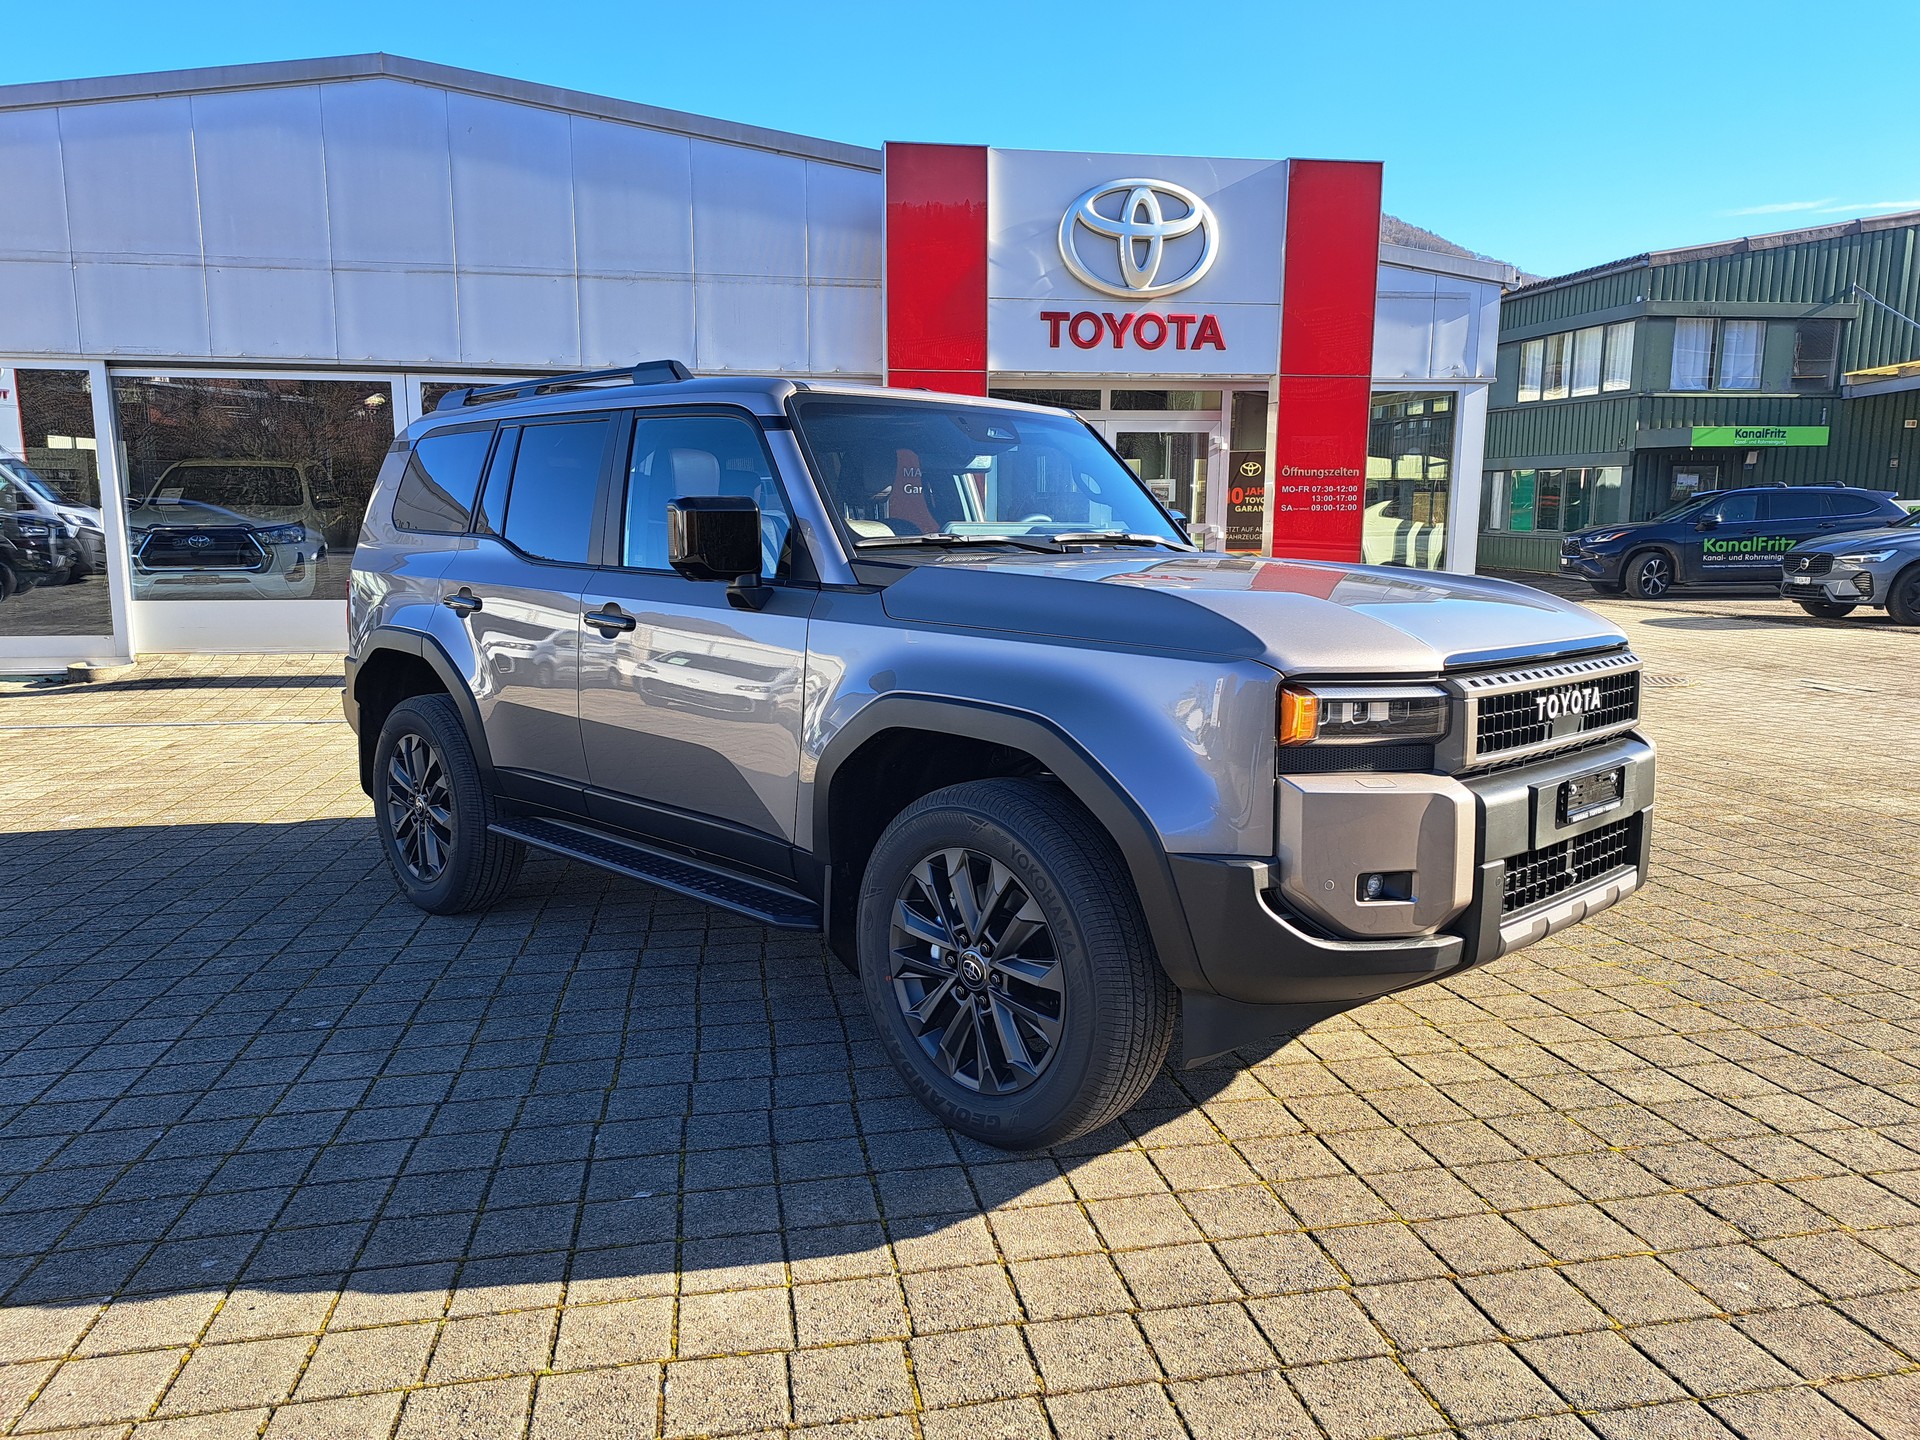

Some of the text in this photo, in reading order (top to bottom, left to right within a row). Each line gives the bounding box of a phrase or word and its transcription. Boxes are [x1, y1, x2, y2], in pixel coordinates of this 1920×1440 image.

[1040, 311, 1227, 350] TOYOTA
[1735, 428, 1787, 438] KanalFritz
[1281, 465, 1360, 479] Öffnungszeiten
[1281, 485, 1358, 493] MO-FR 07:30-12:00
[1311, 494, 1358, 502] 13:00-17:00
[1280, 504, 1293, 512] SA
[1311, 504, 1358, 512] 09:00-12:00
[1703, 536, 1797, 554] KanalFritz
[1702, 554, 1727, 562] Kanal-
[1535, 686, 1601, 721] TOYOTA
[1010, 843, 1077, 956] YOKOHAMA
